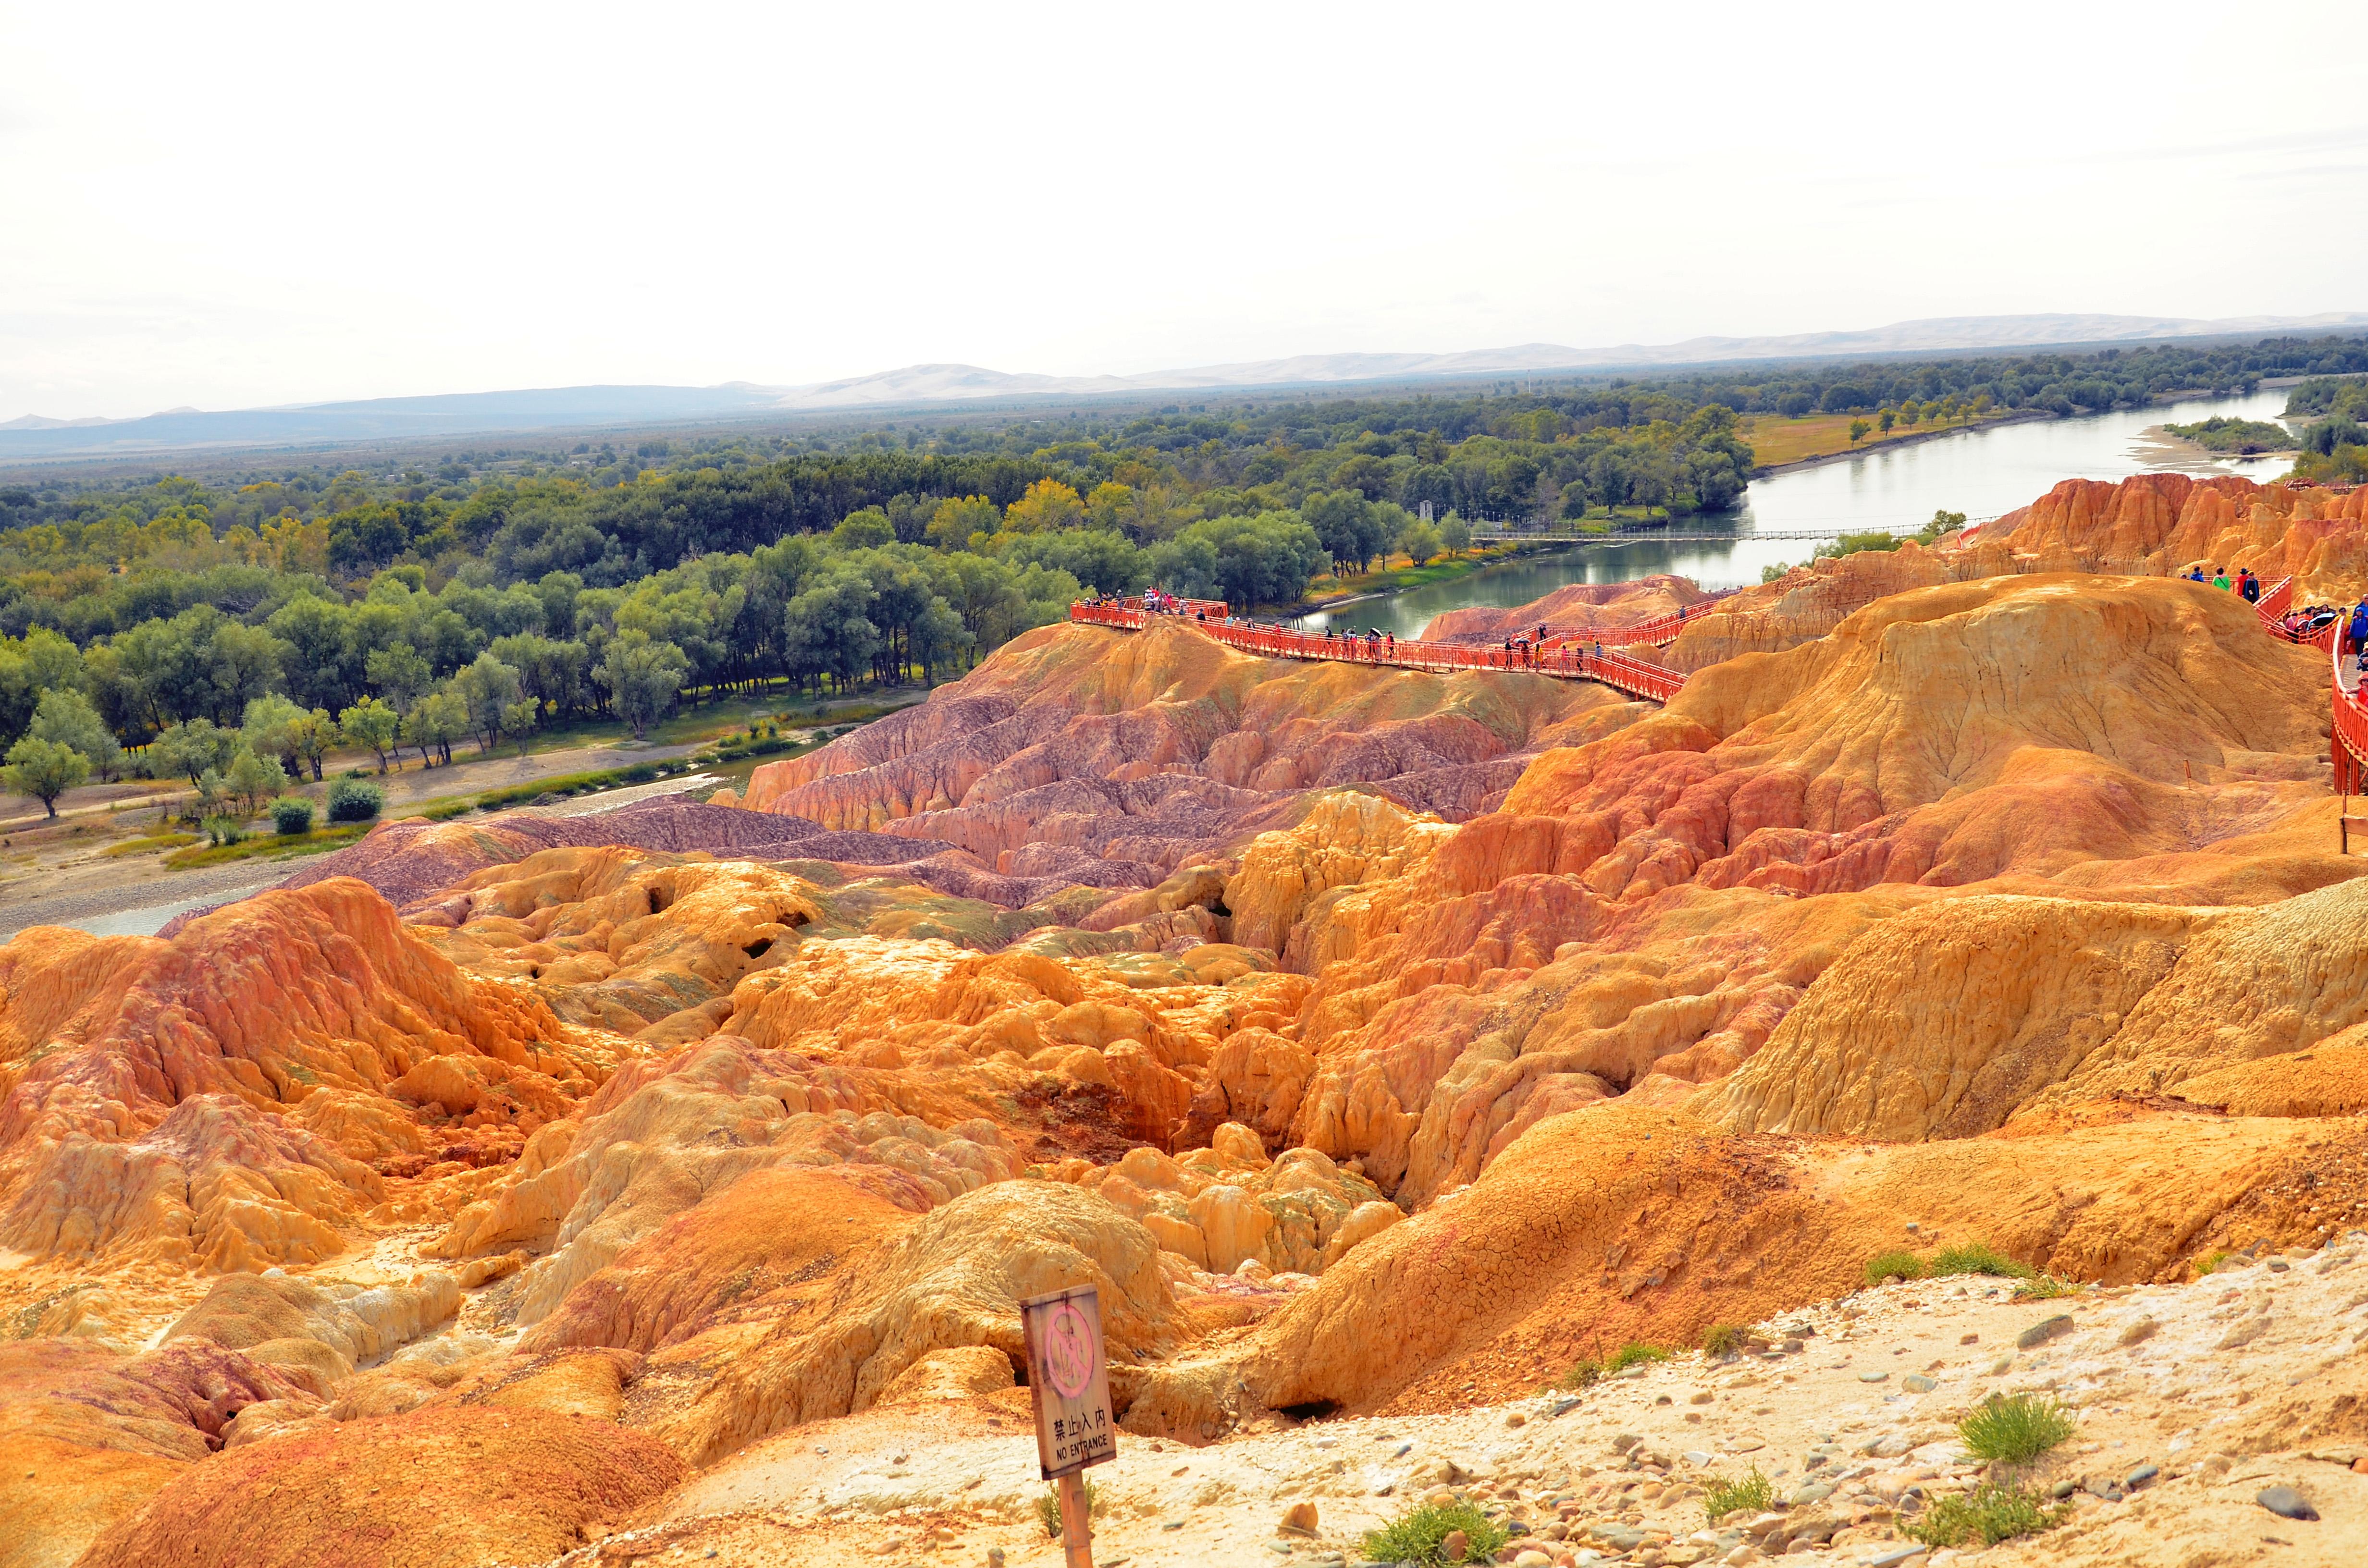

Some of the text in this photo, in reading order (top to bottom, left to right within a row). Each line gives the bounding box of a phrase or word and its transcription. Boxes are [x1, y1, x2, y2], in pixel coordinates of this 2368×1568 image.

[1054, 1406, 1106, 1442] 禁止入内
[1057, 1434, 1107, 1461] NO ENTRANCE
